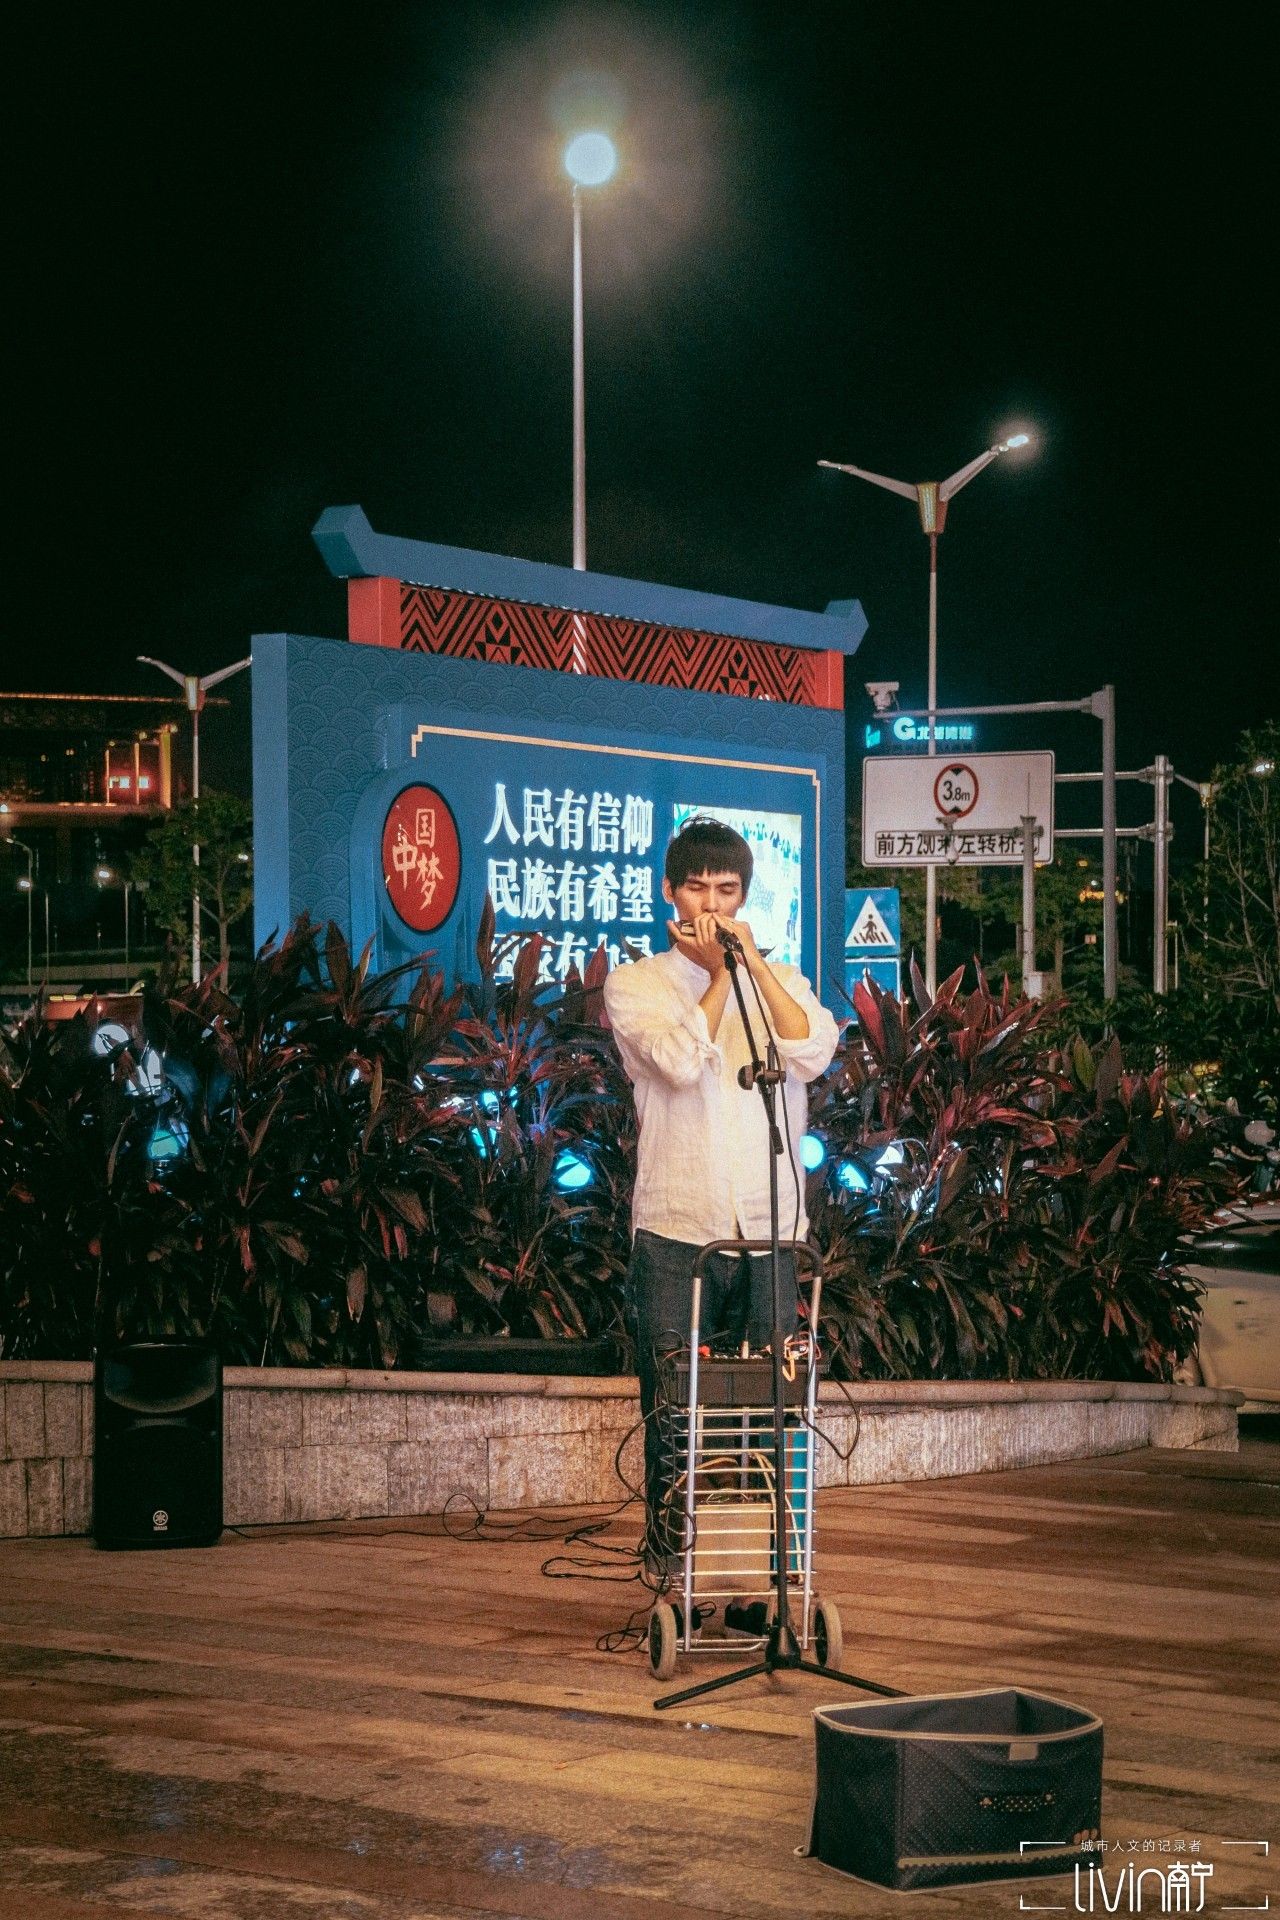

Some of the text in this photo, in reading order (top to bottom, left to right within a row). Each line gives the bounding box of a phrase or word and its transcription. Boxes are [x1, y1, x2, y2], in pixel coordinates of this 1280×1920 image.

[484, 782, 655, 855] 人民有信仰
[943, 780, 971, 801] 3.8m
[488, 858, 655, 923] 民族有希望
